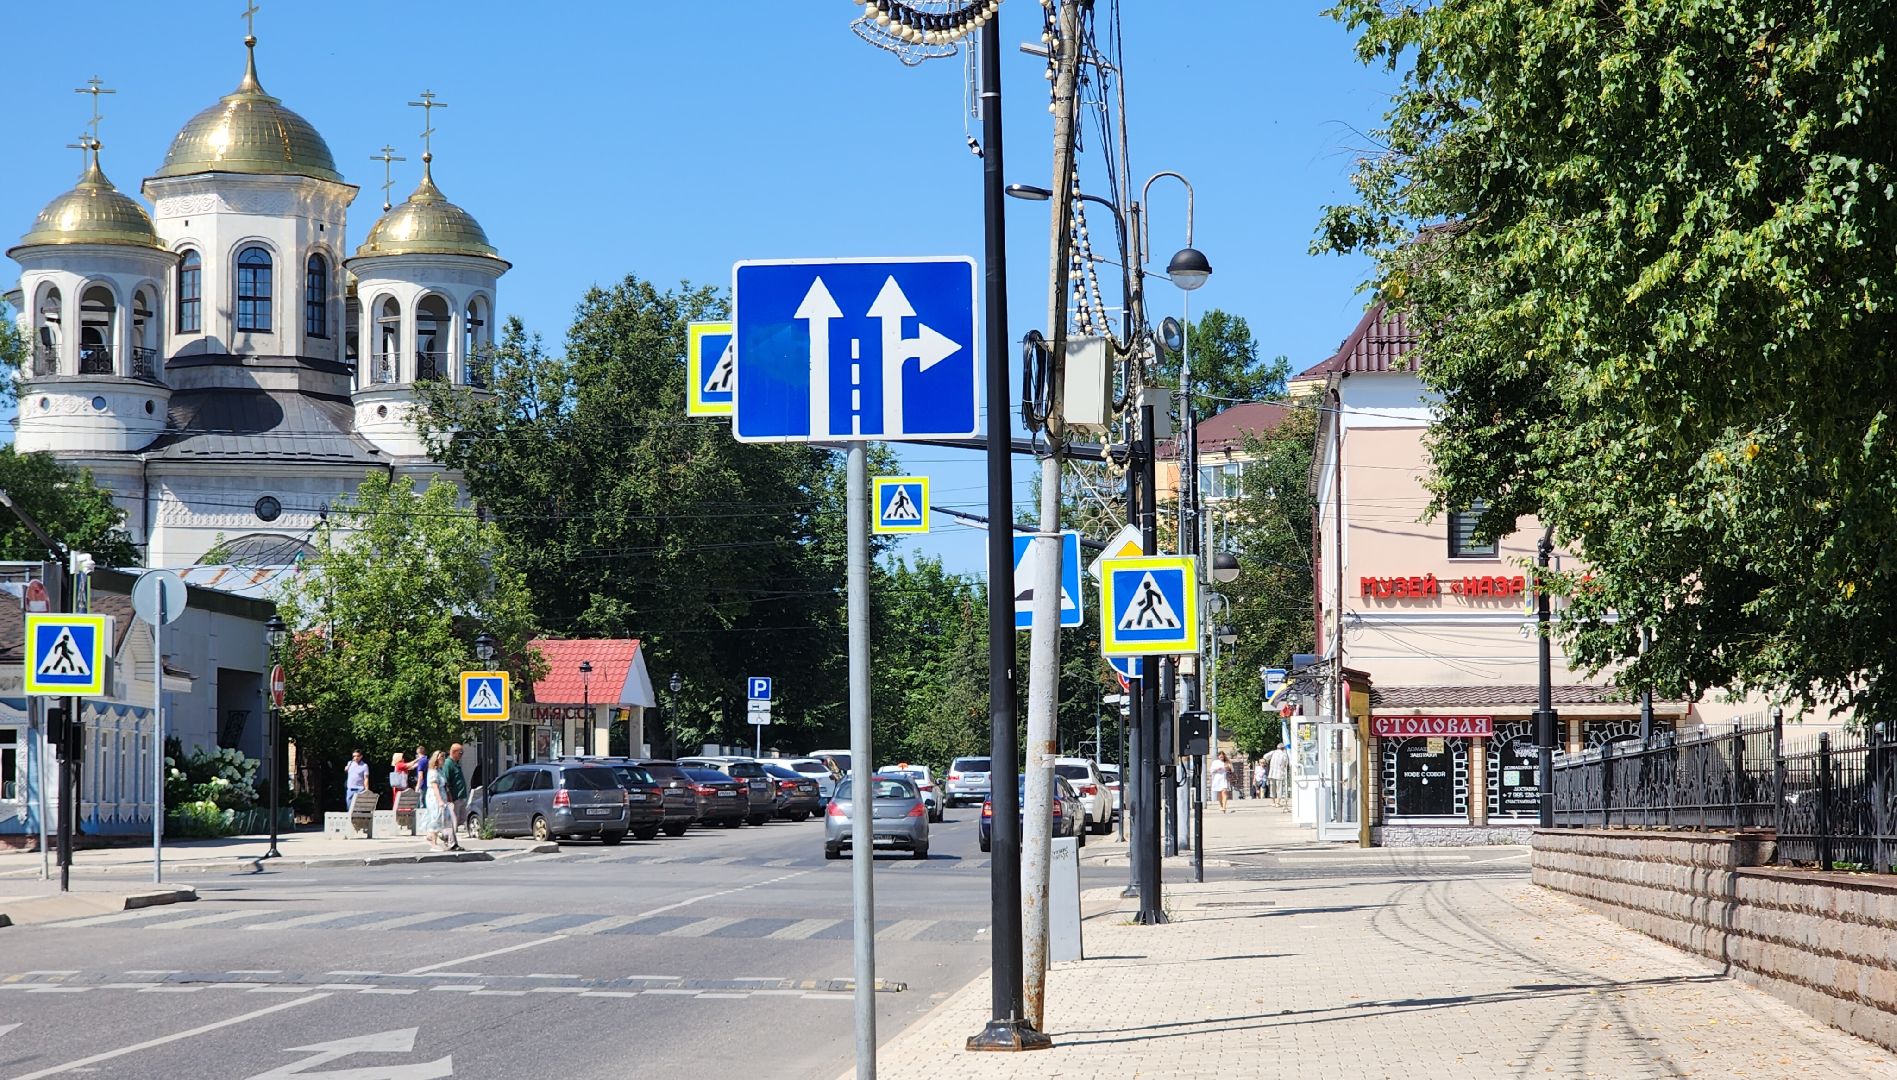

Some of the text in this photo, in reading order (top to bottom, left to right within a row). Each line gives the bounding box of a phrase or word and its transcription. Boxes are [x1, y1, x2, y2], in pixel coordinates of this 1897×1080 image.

[1360, 573, 1540, 598] МУЗЕЙ «НАЗА
[754, 679, 767, 697] P
[1375, 717, 1489, 734] СТОЛОВАЯ
